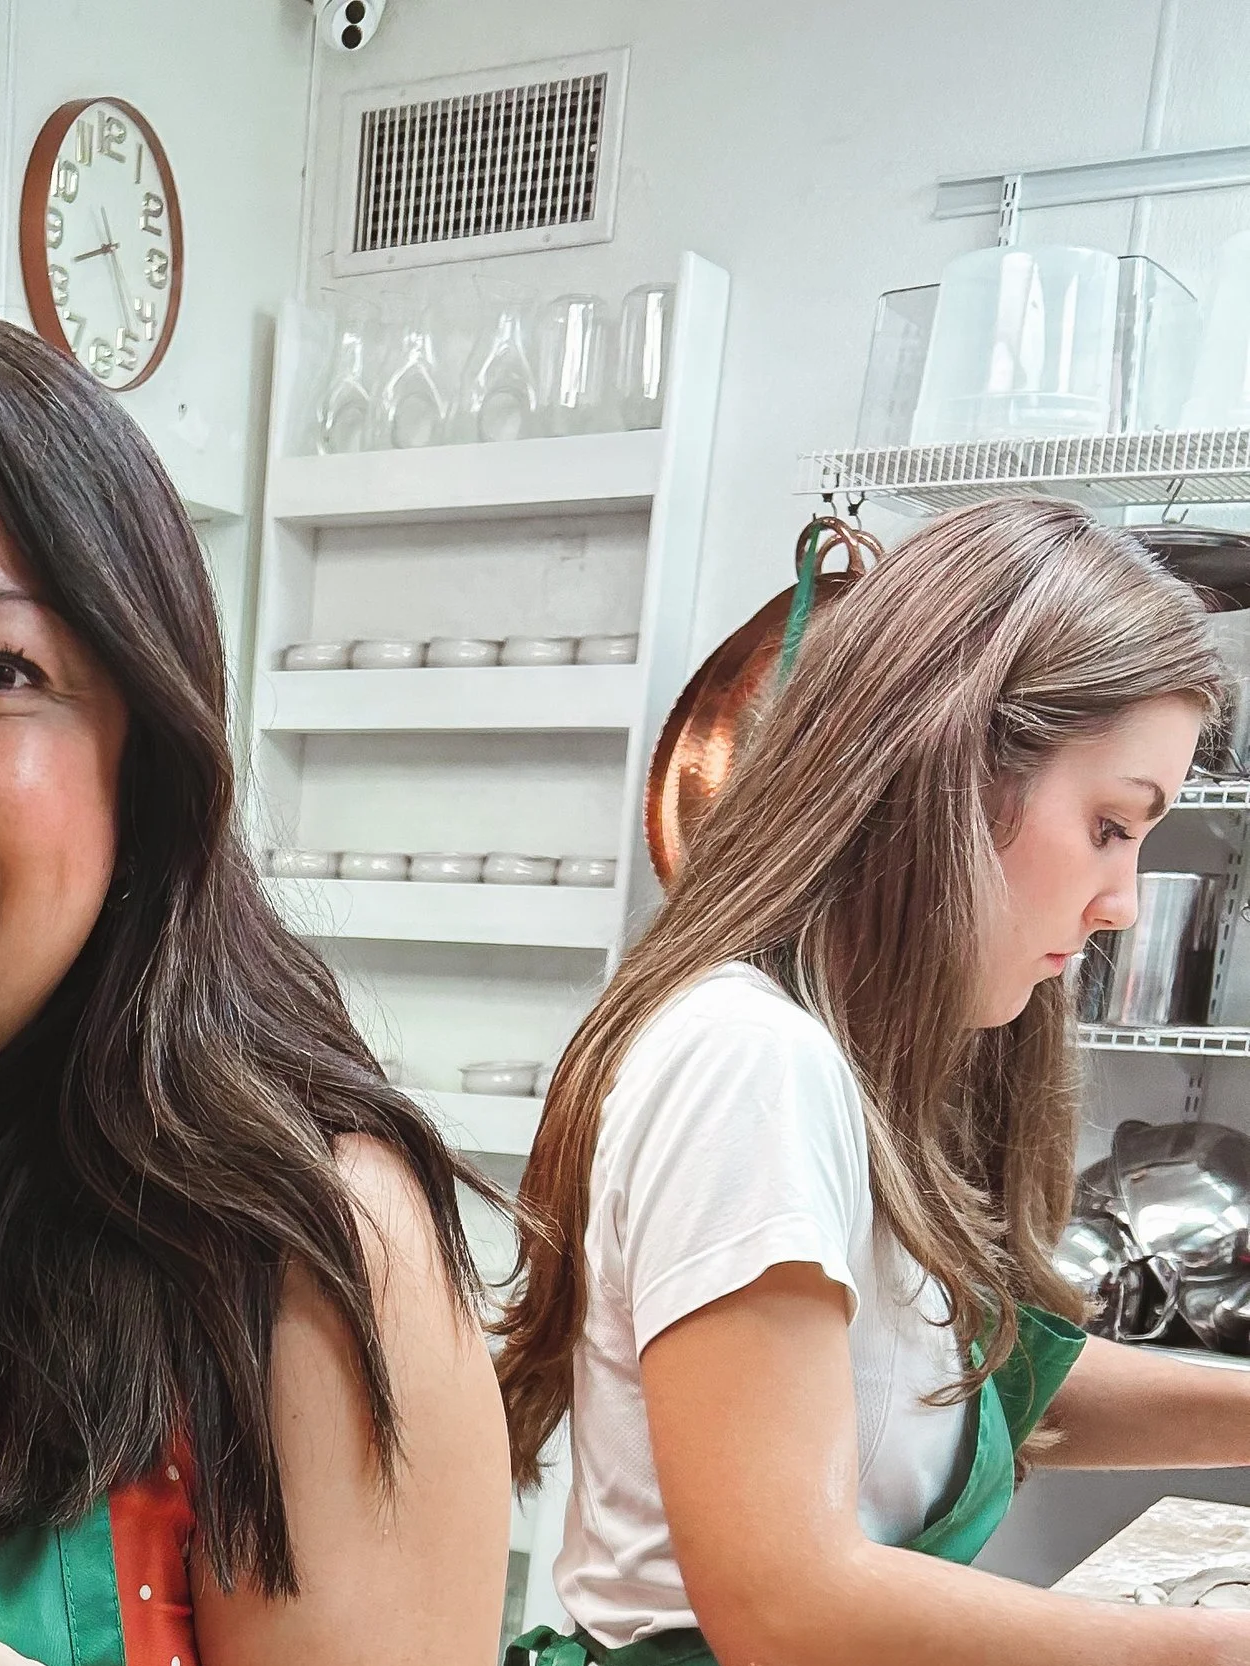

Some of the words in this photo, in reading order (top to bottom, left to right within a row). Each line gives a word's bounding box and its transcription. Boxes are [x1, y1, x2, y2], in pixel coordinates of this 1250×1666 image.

[97, 110, 127, 163] 12
[134, 142, 143, 184] 1
[139, 191, 164, 236] 2
[144, 247, 169, 289] 3
